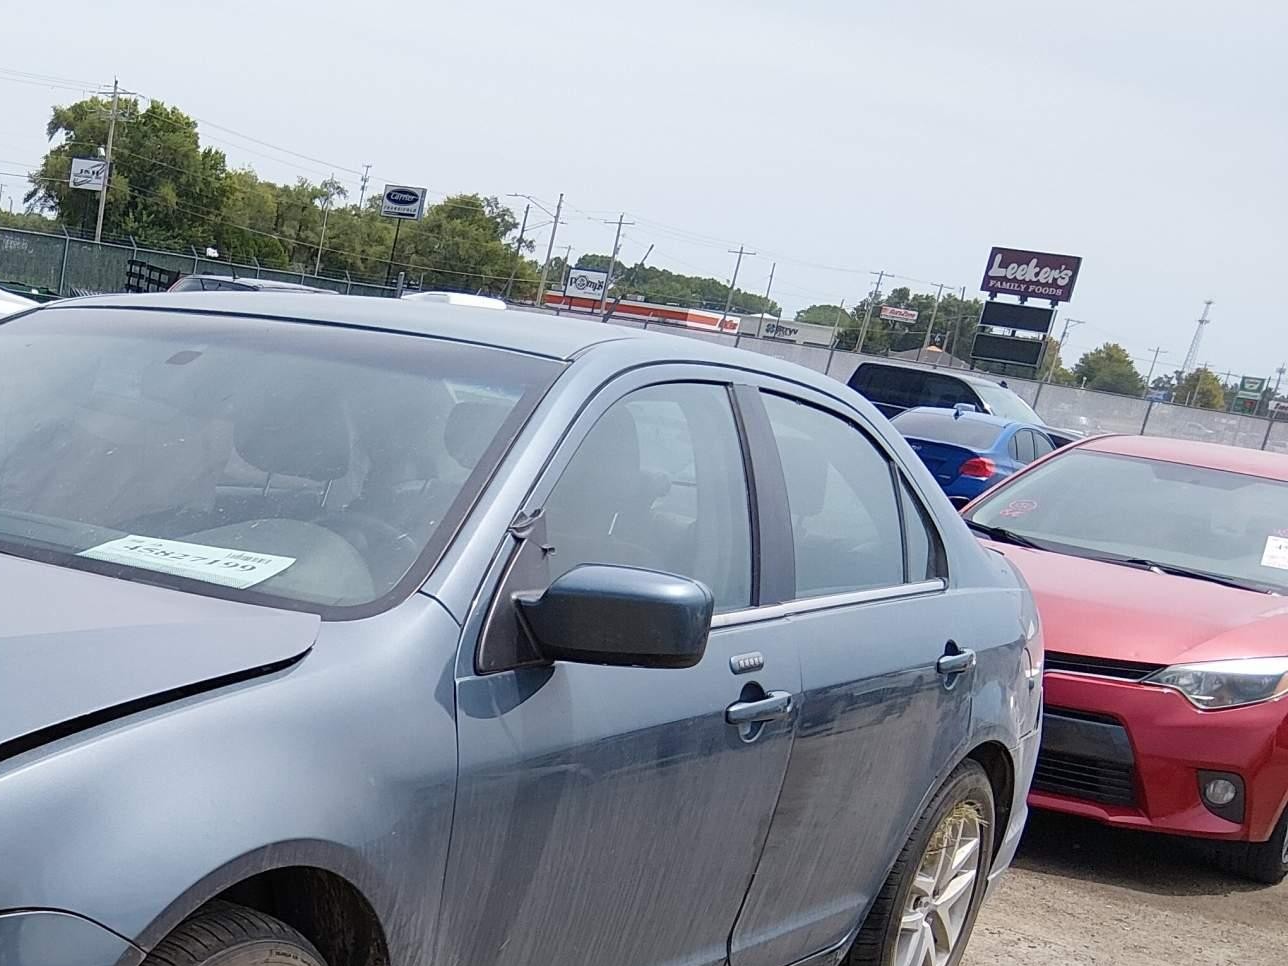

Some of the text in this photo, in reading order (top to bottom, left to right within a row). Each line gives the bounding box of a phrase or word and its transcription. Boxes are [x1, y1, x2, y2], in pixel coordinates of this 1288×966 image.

[391, 191, 418, 202] Carrier
[988, 253, 1073, 286] Leeker's
[989, 280, 1063, 296] FAMILY FOODS
